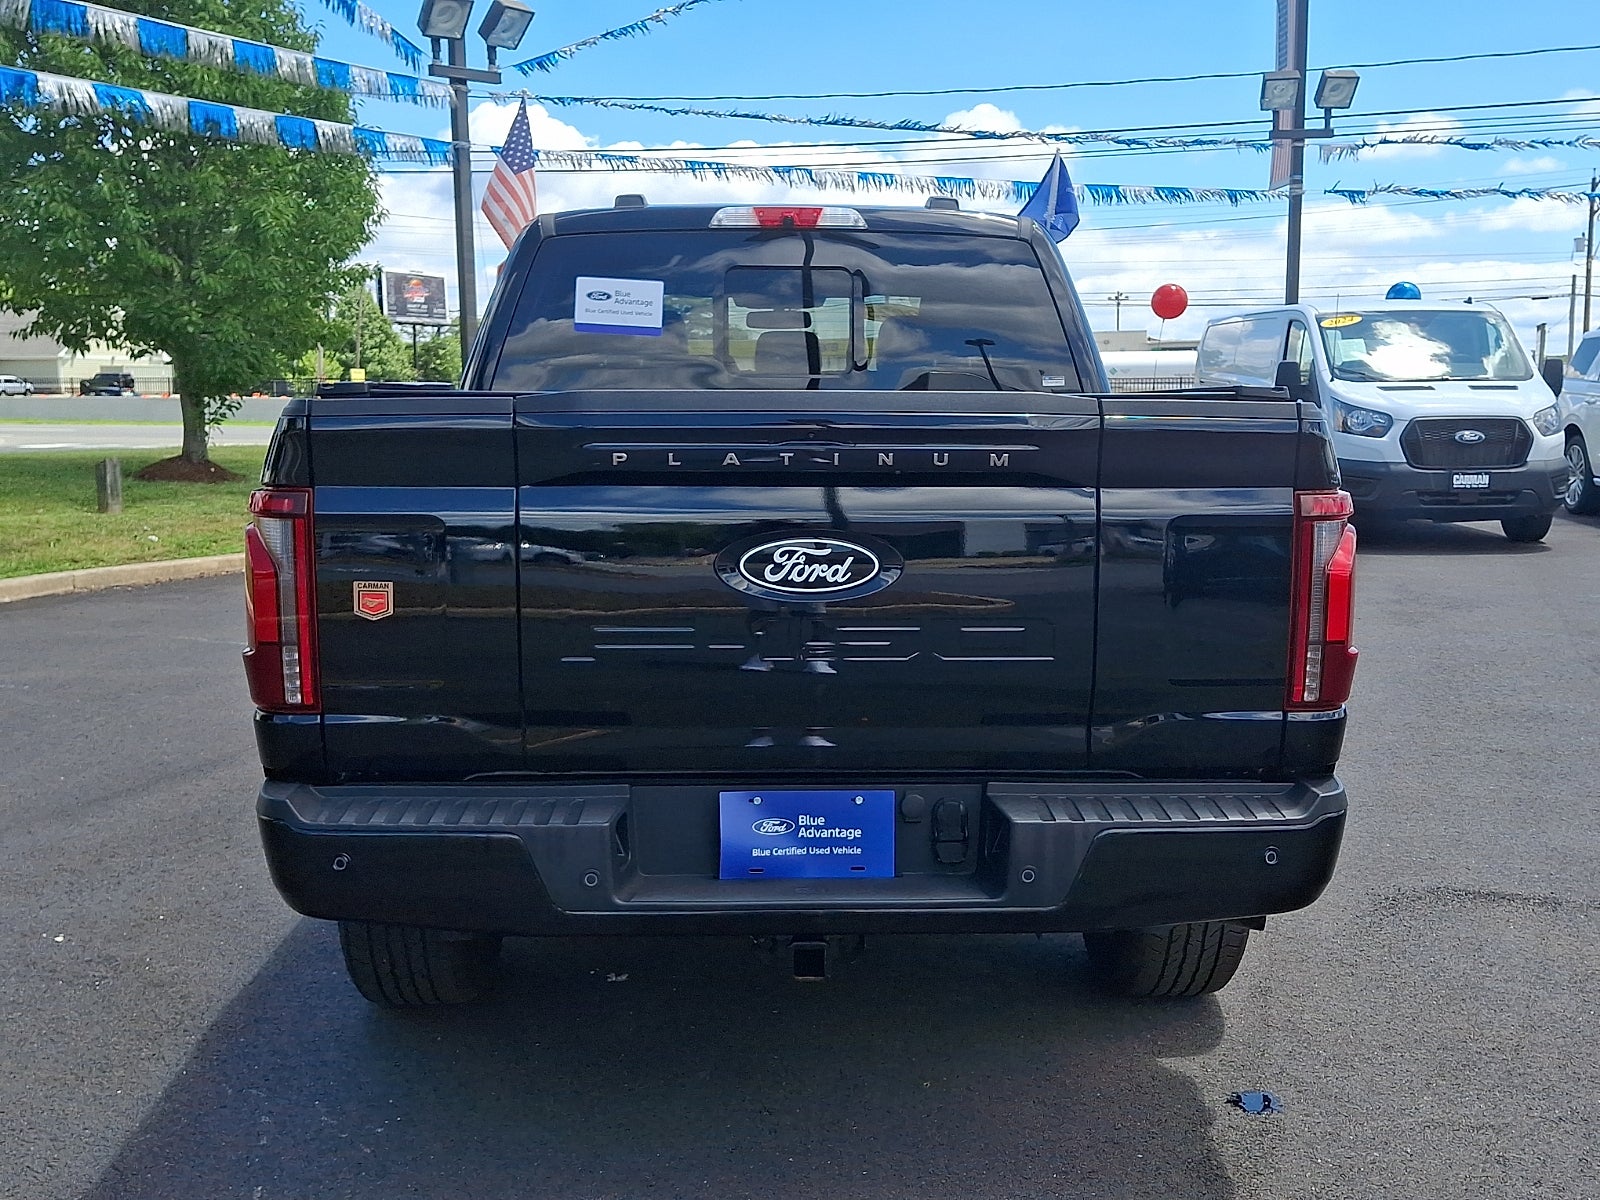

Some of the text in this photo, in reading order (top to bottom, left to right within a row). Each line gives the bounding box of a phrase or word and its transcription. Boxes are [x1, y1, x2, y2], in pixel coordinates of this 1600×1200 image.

[614, 298, 654, 307] Advantage
[611, 452, 1010, 467] PLATINUM
[1453, 474, 1490, 485] CARMAN
[764, 546, 855, 583] Ford
[798, 815, 826, 826] Blue
[760, 820, 788, 833] Ford
[798, 827, 862, 839] Advantage
[752, 846, 862, 857] Blue Certified Used Vehicle
